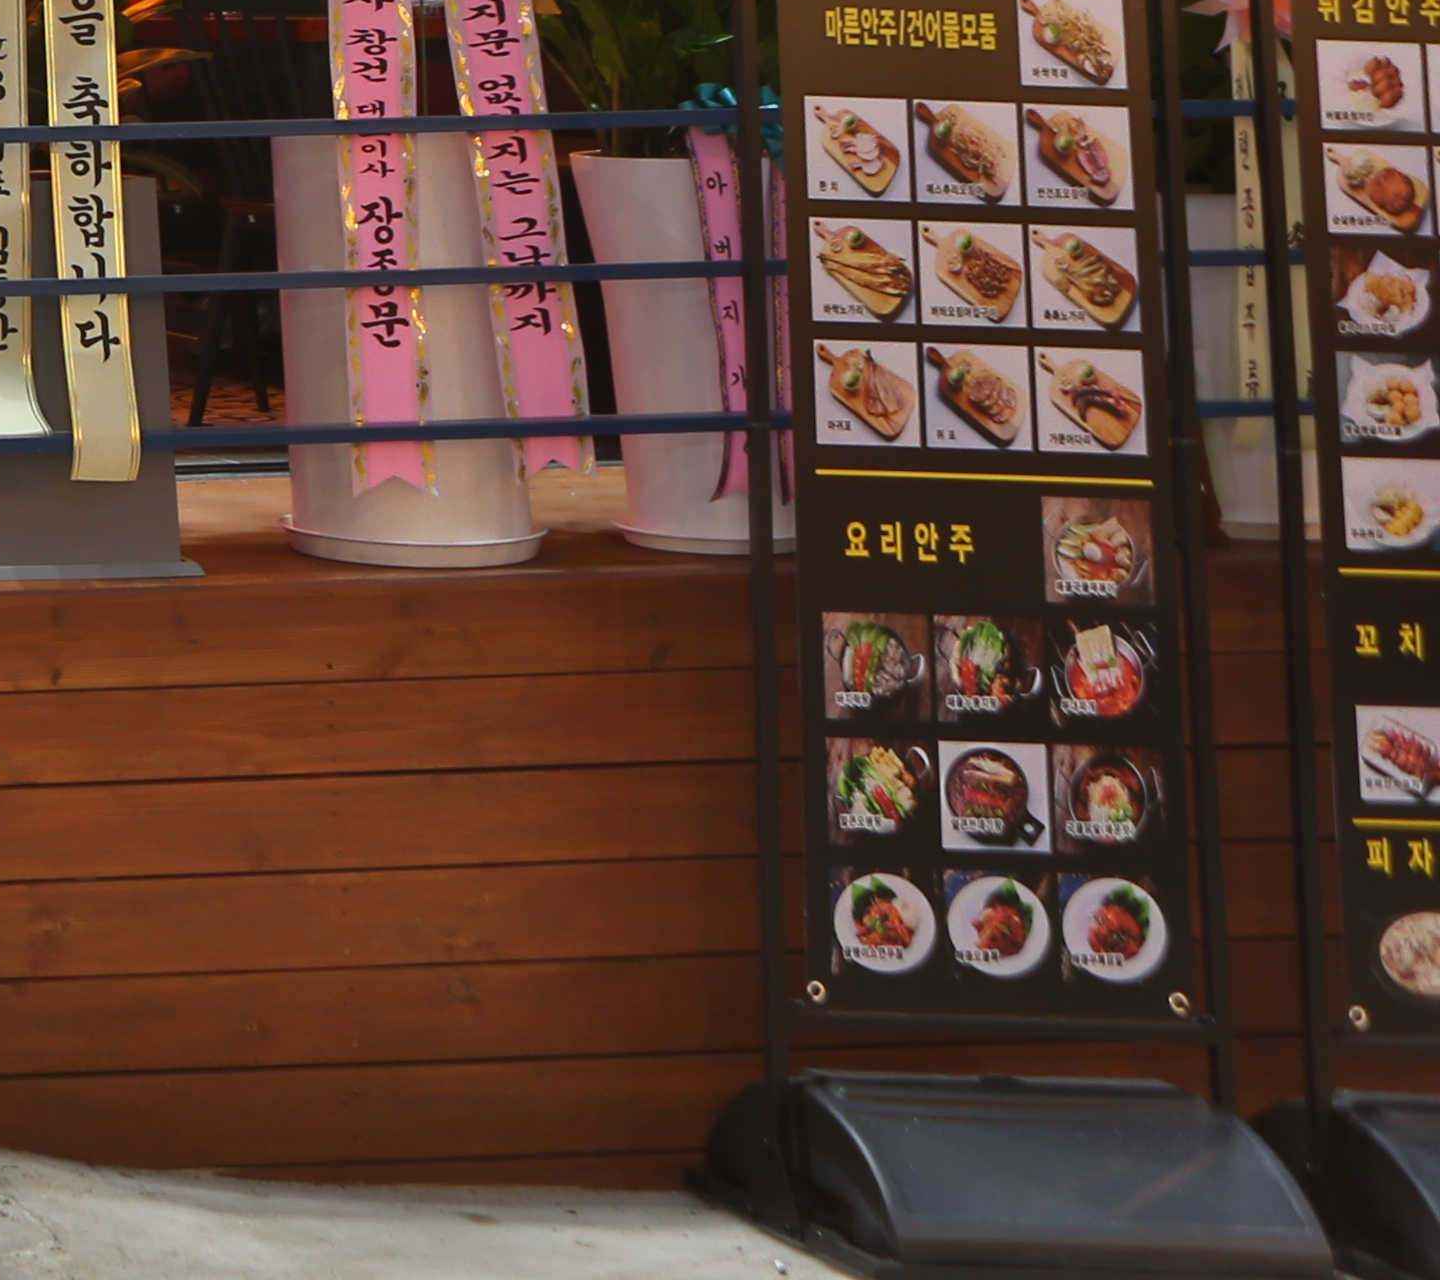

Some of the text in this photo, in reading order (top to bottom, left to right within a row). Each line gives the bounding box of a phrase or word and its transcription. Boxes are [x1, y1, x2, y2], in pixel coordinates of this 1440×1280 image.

[825, 6, 997, 51] 마른안주/건어물모둠
[346, 28, 397, 83] 창건
[356, 99, 396, 179] 대이사
[62, 75, 122, 364] 축하합니다
[844, 521, 975, 565] 요리안주
[1365, 836, 1435, 878] 피자
